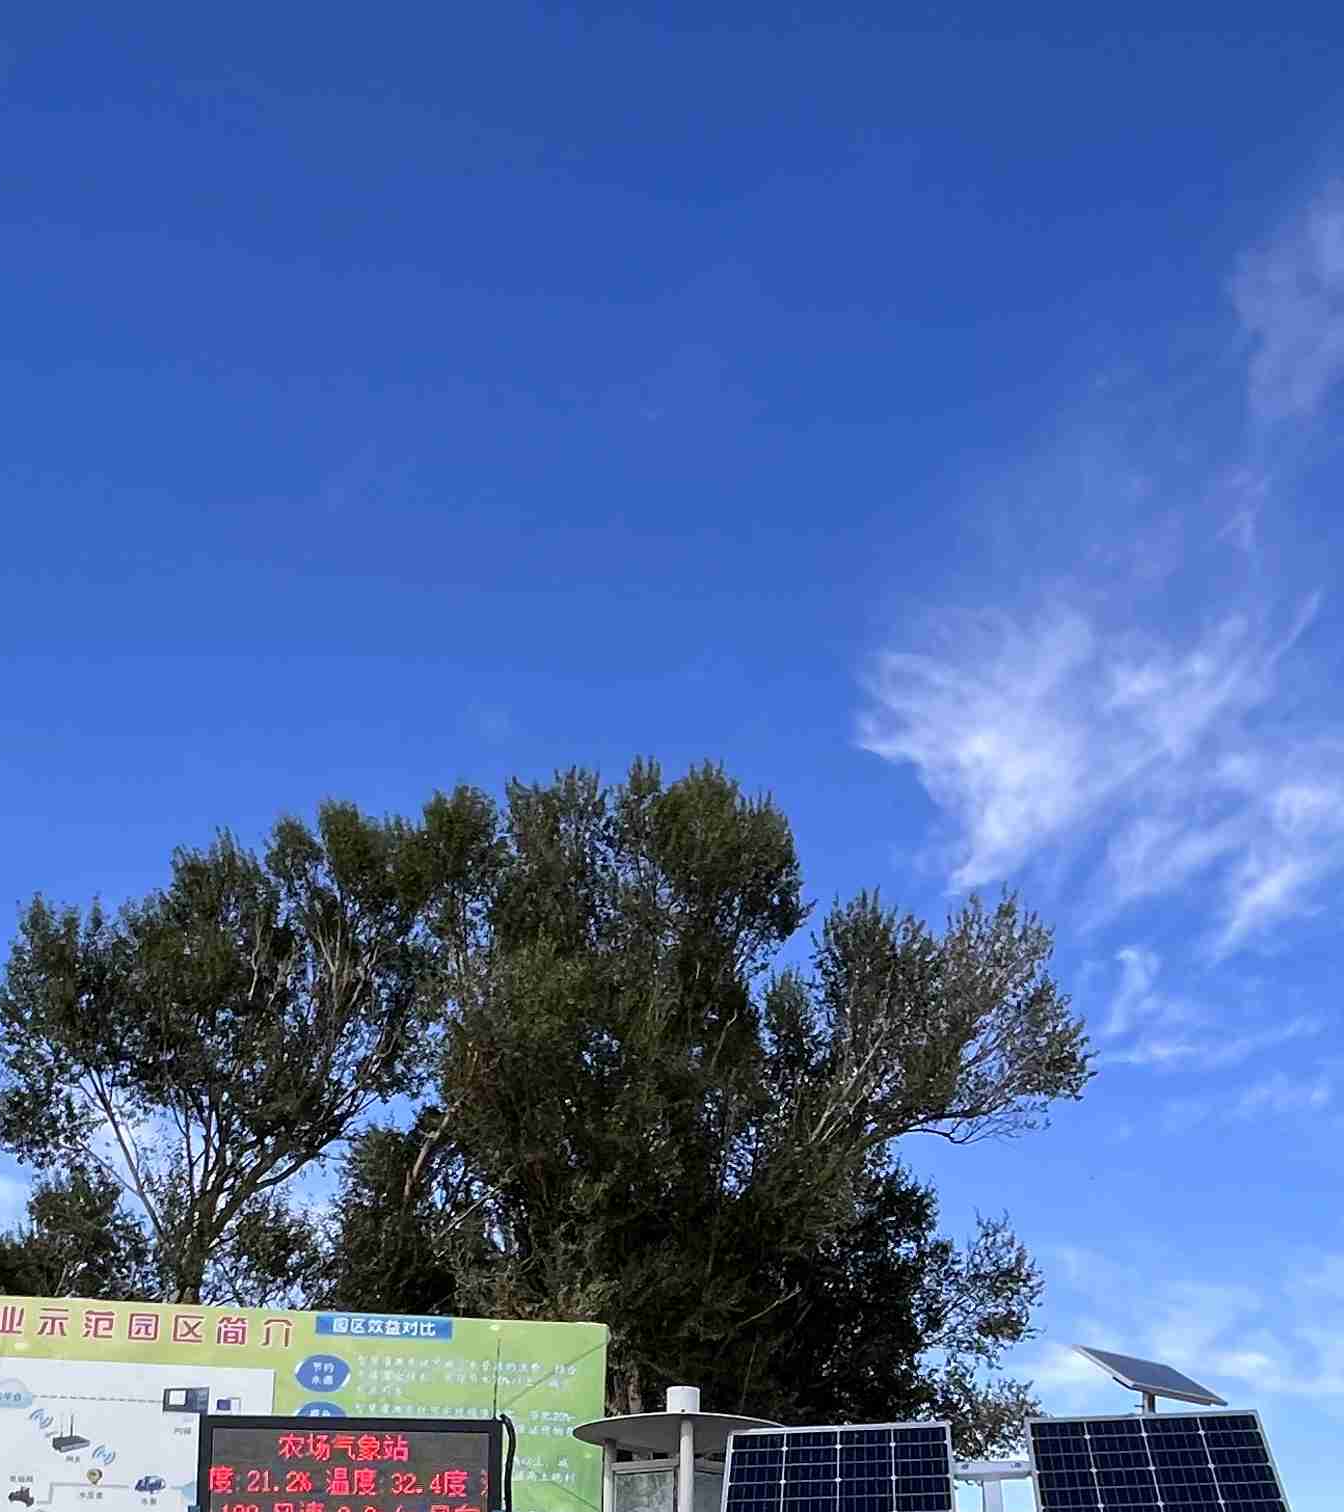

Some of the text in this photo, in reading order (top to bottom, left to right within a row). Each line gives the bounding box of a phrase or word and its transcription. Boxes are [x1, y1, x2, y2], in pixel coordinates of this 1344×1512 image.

[332, 1317, 437, 1337] 园区效益对比
[278, 1433, 409, 1462] 农场气象站
